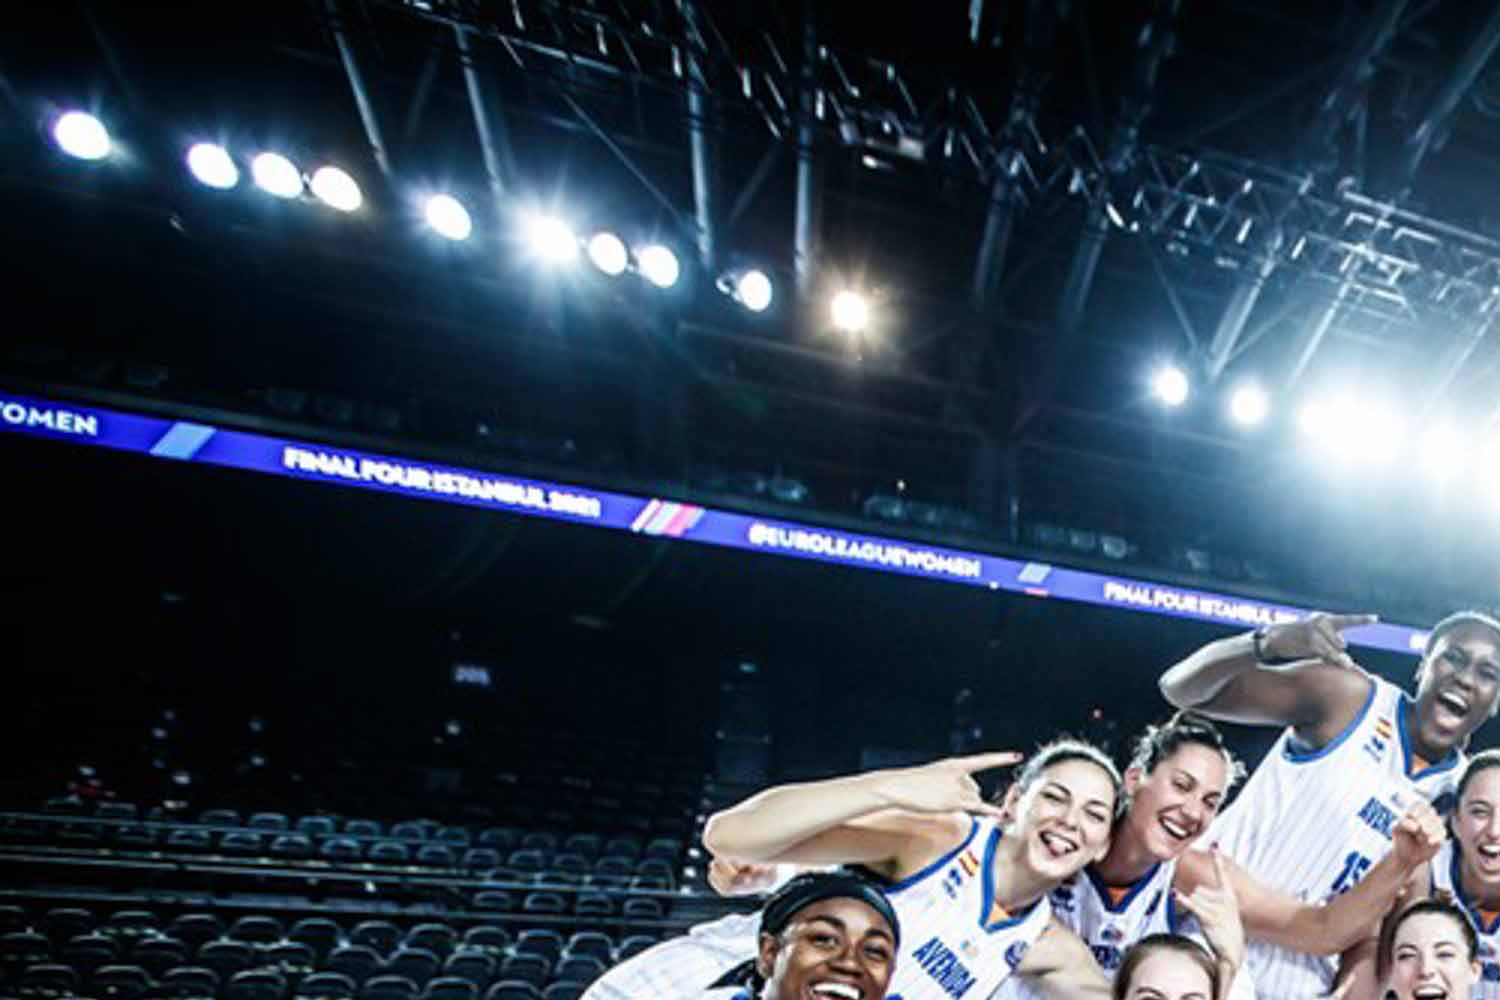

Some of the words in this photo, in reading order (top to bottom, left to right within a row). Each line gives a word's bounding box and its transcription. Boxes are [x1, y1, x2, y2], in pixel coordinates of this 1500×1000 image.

[0, 401, 98, 436] OMEN
[284, 446, 359, 480] FINAL
[359, 460, 433, 492] FOUR
[749, 522, 981, 578] @EUROLEAGUEWOMEN
